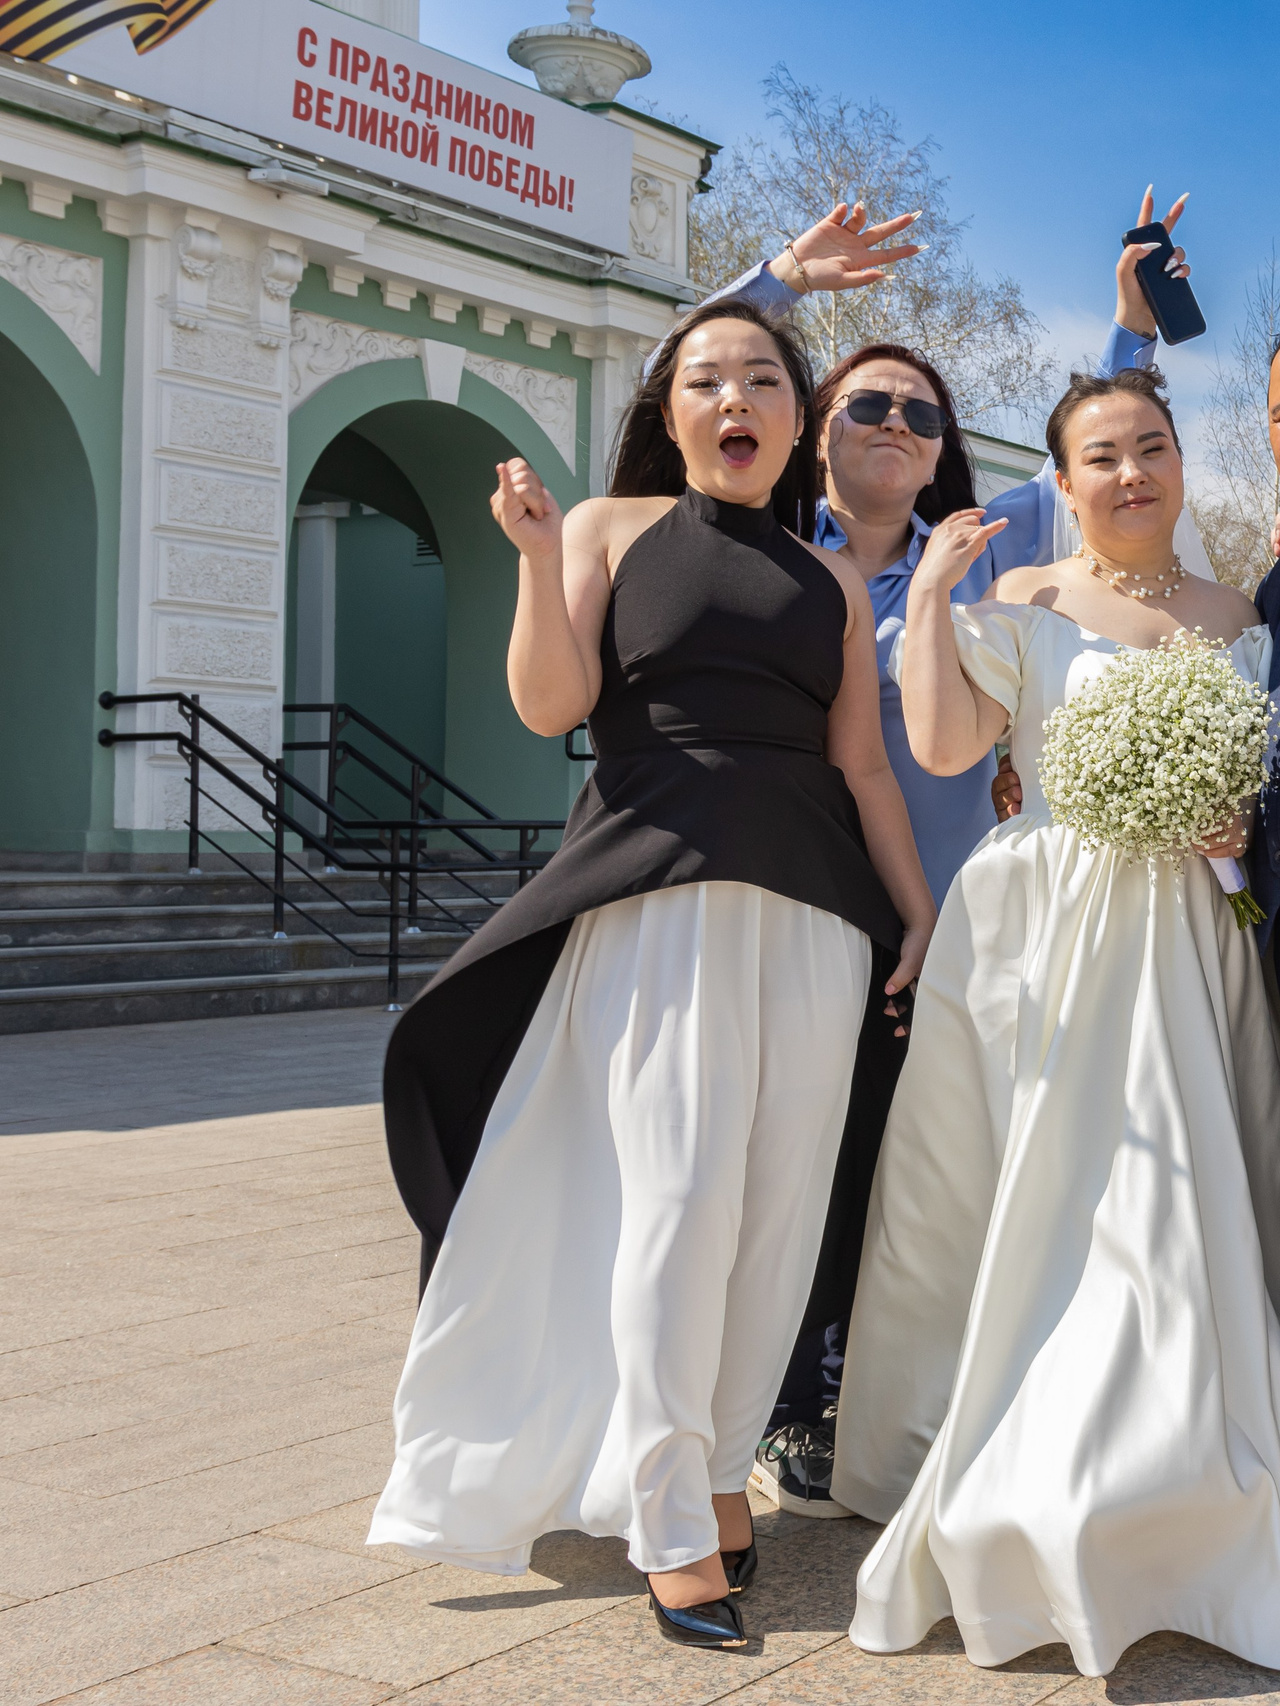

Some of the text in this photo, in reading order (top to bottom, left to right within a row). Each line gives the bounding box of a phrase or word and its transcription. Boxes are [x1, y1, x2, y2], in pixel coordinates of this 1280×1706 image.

[292, 80, 575, 213] ВЕЛИКОЙ ПОБЕДЫ!
[297, 27, 535, 150] С ПРАЗДНИКОМ
